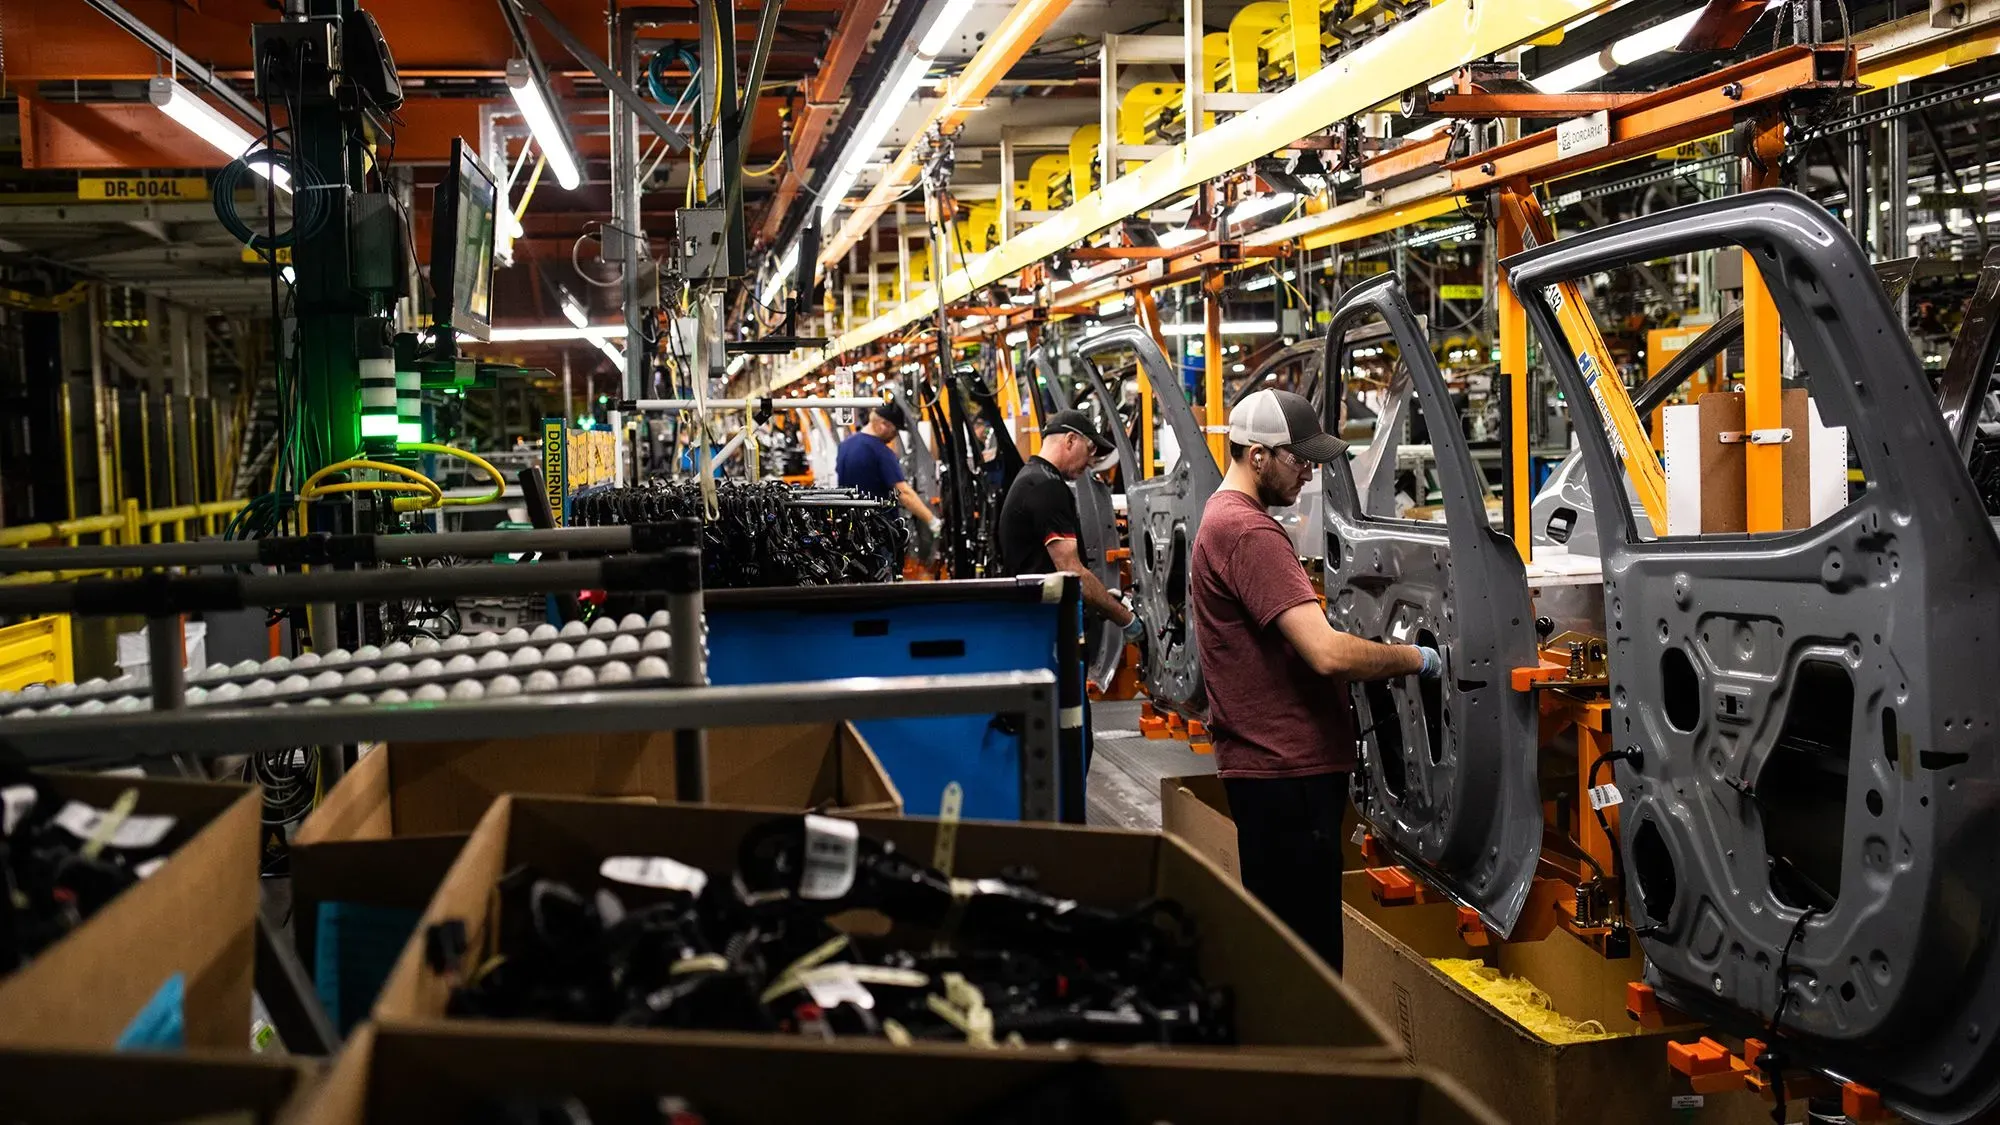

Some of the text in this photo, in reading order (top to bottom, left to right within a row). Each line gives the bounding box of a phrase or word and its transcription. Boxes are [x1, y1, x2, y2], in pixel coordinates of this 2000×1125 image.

[104, 181, 181, 197] DR-004L
[1578, 351, 1602, 388] HTI
[1594, 385, 1627, 458] CYBERNETICS
